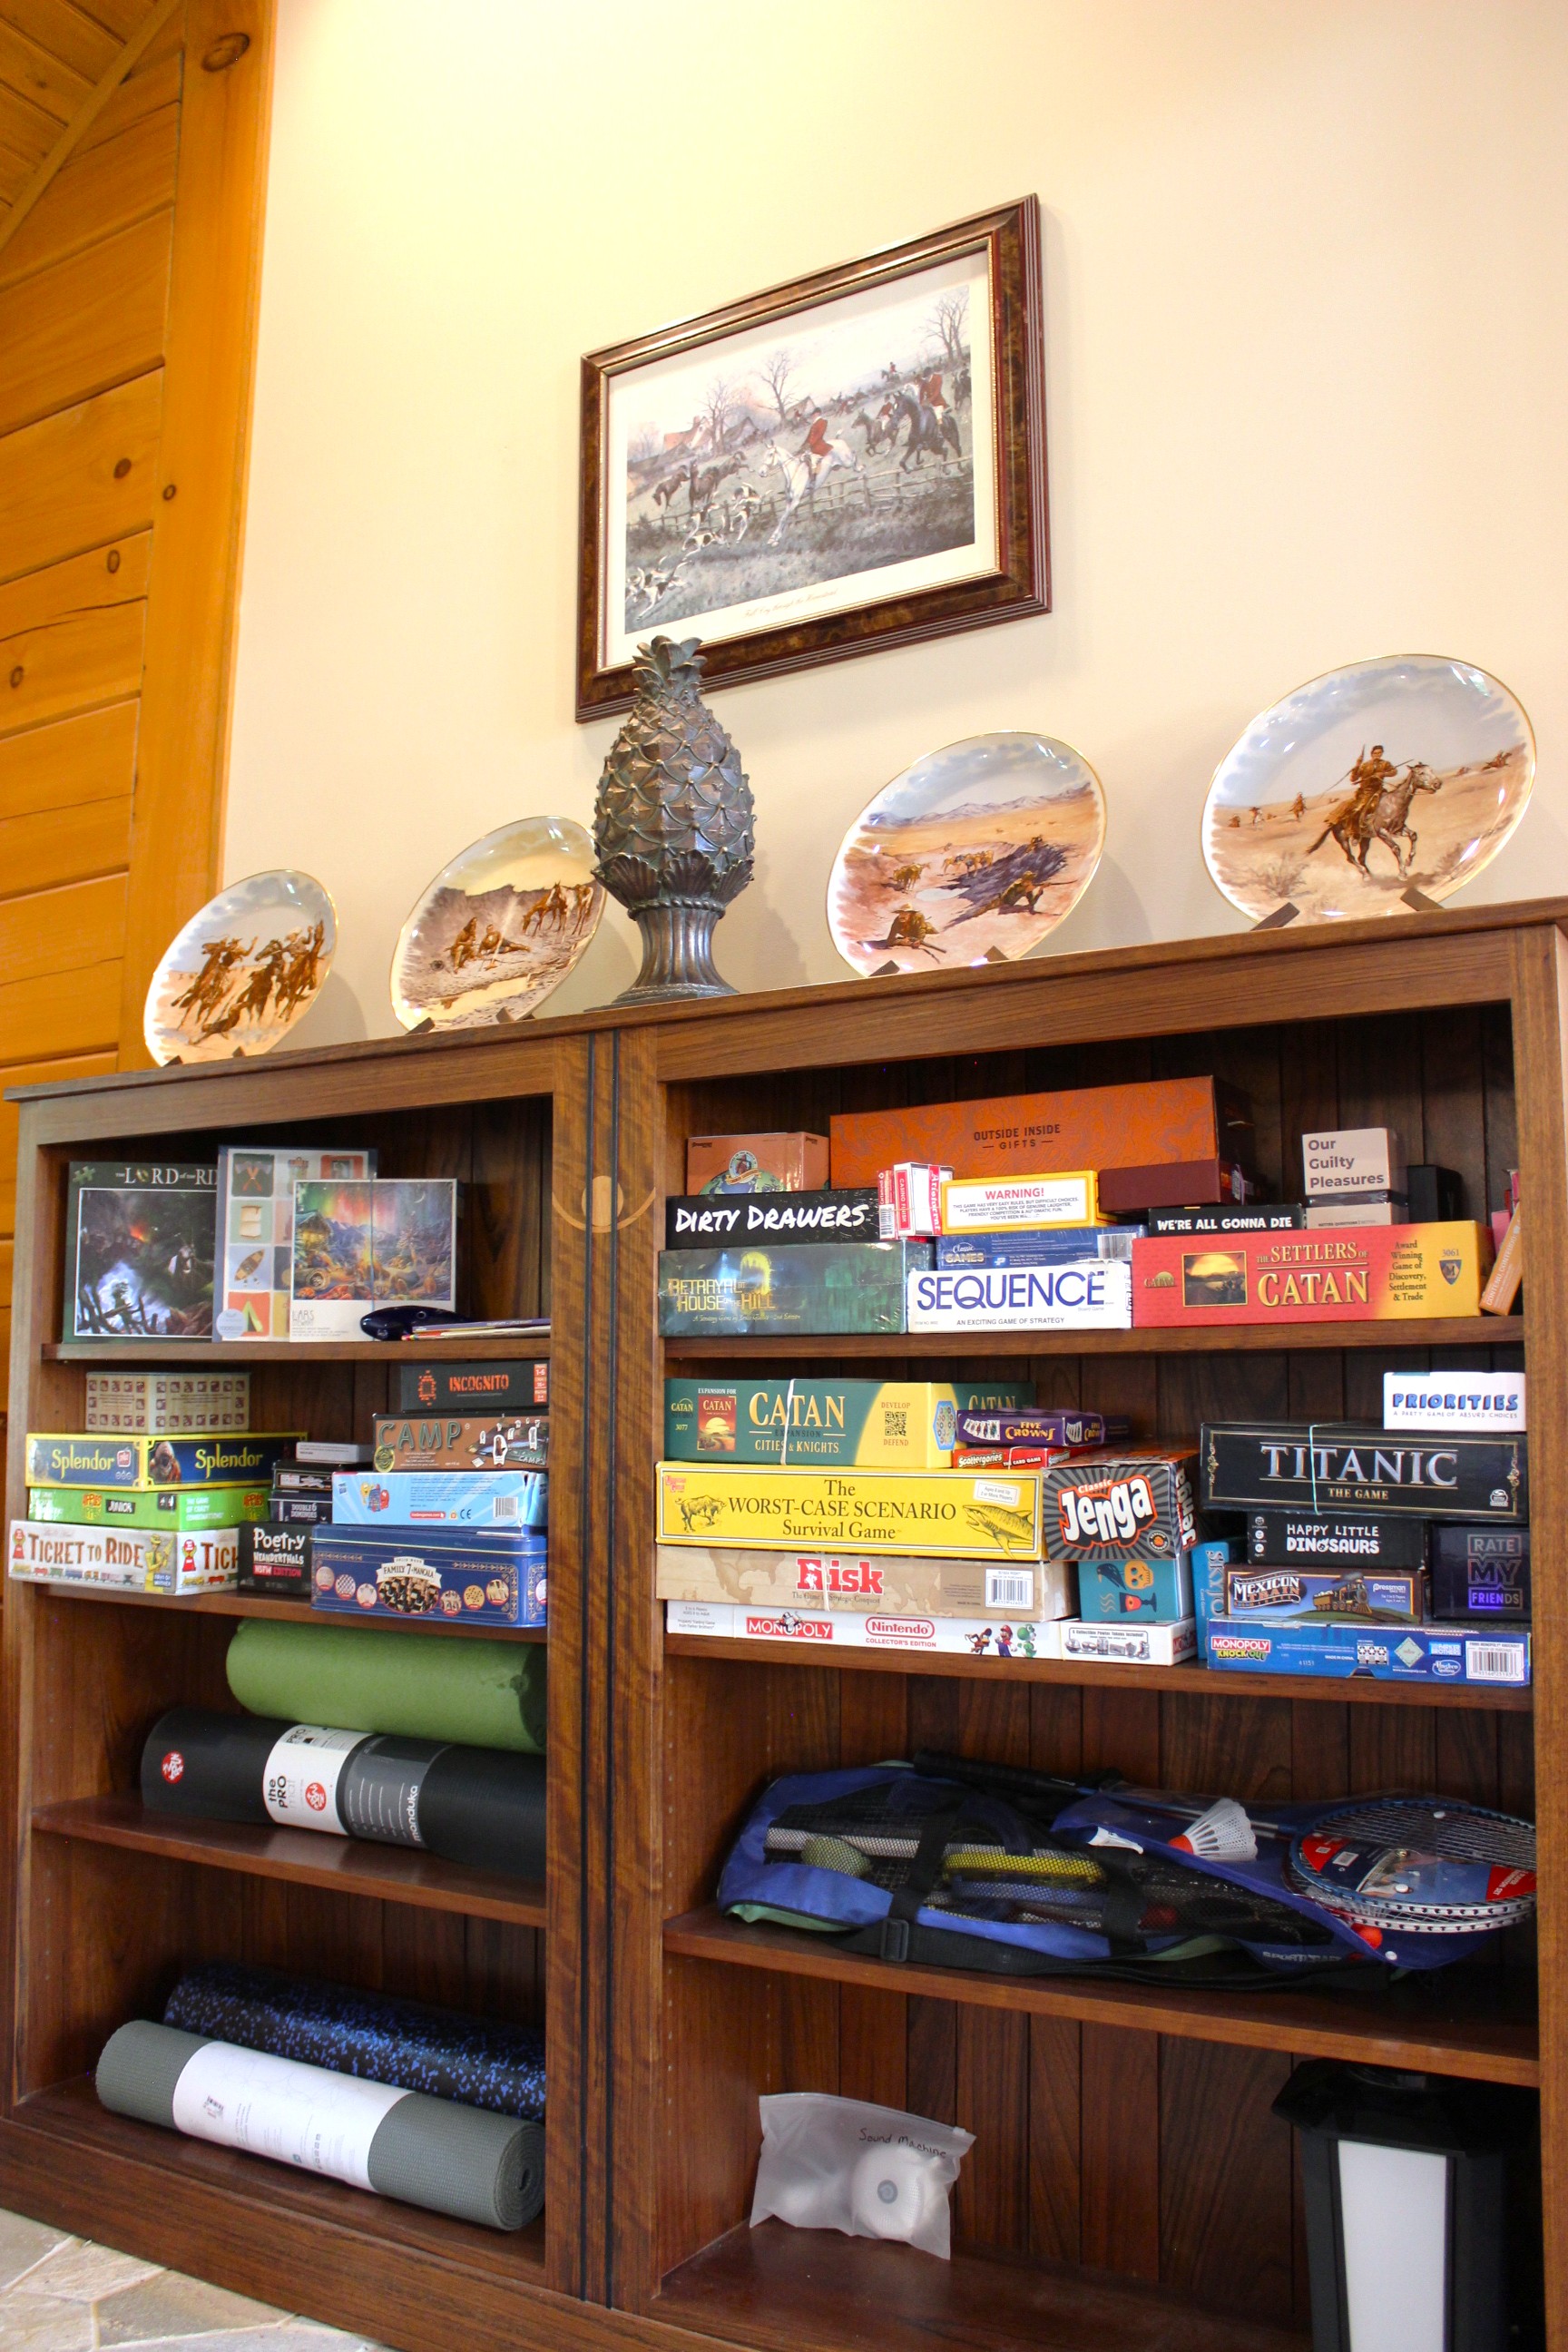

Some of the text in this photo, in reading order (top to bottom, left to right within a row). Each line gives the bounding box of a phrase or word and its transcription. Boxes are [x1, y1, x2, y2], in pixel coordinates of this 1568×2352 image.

[974, 1123, 1061, 1141] OUTSIDE INSIDE
[999, 1139, 1036, 1150] GIFTS
[1308, 1139, 1336, 1151] Our
[1308, 1156, 1355, 1170] Guilty
[1309, 1174, 1385, 1189] Pleasures
[985, 1187, 1044, 1200] WARNING!
[675, 1204, 870, 1233] DIRTY DRAWERS
[1156, 1217, 1293, 1230] WE'RE ALL GONNA DIE
[1394, 1240, 1418, 1250] Award
[945, 1252, 985, 1265] GAMES
[1257, 1255, 1269, 1264] THE
[1270, 1242, 1357, 1263] SETTLERS
[1391, 1250, 1423, 1260] Winning
[1441, 1249, 1460, 1257] 3061
[1392, 1257, 1423, 1270] Game of
[1144, 1277, 1176, 1288] CATAN
[1388, 1272, 1427, 1282] Discovery,
[668, 1278, 743, 1297] BETRAYAL
[916, 1270, 1105, 1311] SEQUENCE
[1258, 1271, 1370, 1307] CATAN
[1388, 1282, 1427, 1291] Settlement
[676, 1292, 777, 1312] HOUSE HILL
[1393, 1292, 1424, 1301] & Trade
[449, 1374, 510, 1393] INCOGNITO
[671, 1403, 693, 1413] CATAN
[702, 1399, 732, 1411] CATAN
[881, 1401, 911, 1409] DEVELOP
[1392, 1393, 1519, 1411] PRIORITIES
[749, 1391, 846, 1429] CATAN
[1020, 1421, 1043, 1429] FIVE
[378, 1421, 462, 1451] CAMP
[774, 1428, 822, 1438] EXPANSION
[1004, 1426, 1055, 1441] CROWNS
[754, 1439, 840, 1454] CITIES & KNIGHTS
[883, 1438, 909, 1446] DEFEND
[51, 1444, 115, 1479] Splendor
[194, 1443, 263, 1479] Splendor
[958, 1452, 1004, 1468] Scattergories
[1260, 1445, 1458, 1487] TITANIC
[823, 1479, 856, 1496] The
[1077, 1478, 1113, 1494] Classic
[1328, 1487, 1389, 1500] THE GAME
[107, 1501, 133, 1514] JUNIOR
[729, 1497, 956, 1520] WORST-CASE SCENARIO
[1061, 1478, 1154, 1542] Jenga
[1176, 1466, 1197, 1546] Jenga
[782, 1519, 897, 1539] Survival Game
[1287, 1524, 1379, 1537] HAPPY LITTLE
[253, 1527, 306, 1551] Poetry
[1286, 1536, 1380, 1554] DINOSAURS
[1474, 1538, 1516, 1553] RATE
[28, 1534, 144, 1569] TICKET TO RIDE
[253, 1553, 305, 1566] NEANDERTHALS
[273, 1567, 301, 1577] EDITION
[383, 1565, 406, 1574] FAMILY
[796, 1556, 885, 1595] Risk
[1467, 1558, 1522, 1585] MY
[1205, 1550, 1225, 1616] SKYJO
[1372, 1583, 1406, 1592] pressman
[792, 1591, 880, 1604] The Game Strategic Conquest
[1248, 1586, 1300, 1602] TRAIN
[1472, 1592, 1520, 1605] FRIENDS
[870, 1620, 928, 1634] Nintendo
[865, 1637, 936, 1648] COLLECTOR'S EDITION
[1212, 1638, 1269, 1651] MONOPOLY
[1217, 1650, 1248, 1660] KNOCK
[286, 1728, 307, 1745] PRO
[268, 1779, 277, 1802] the
[277, 1775, 289, 1808] PRO
[288, 1779, 298, 1809] mat
[405, 1784, 422, 1842] manduka
[858, 2127, 946, 2159] Sound Machine
